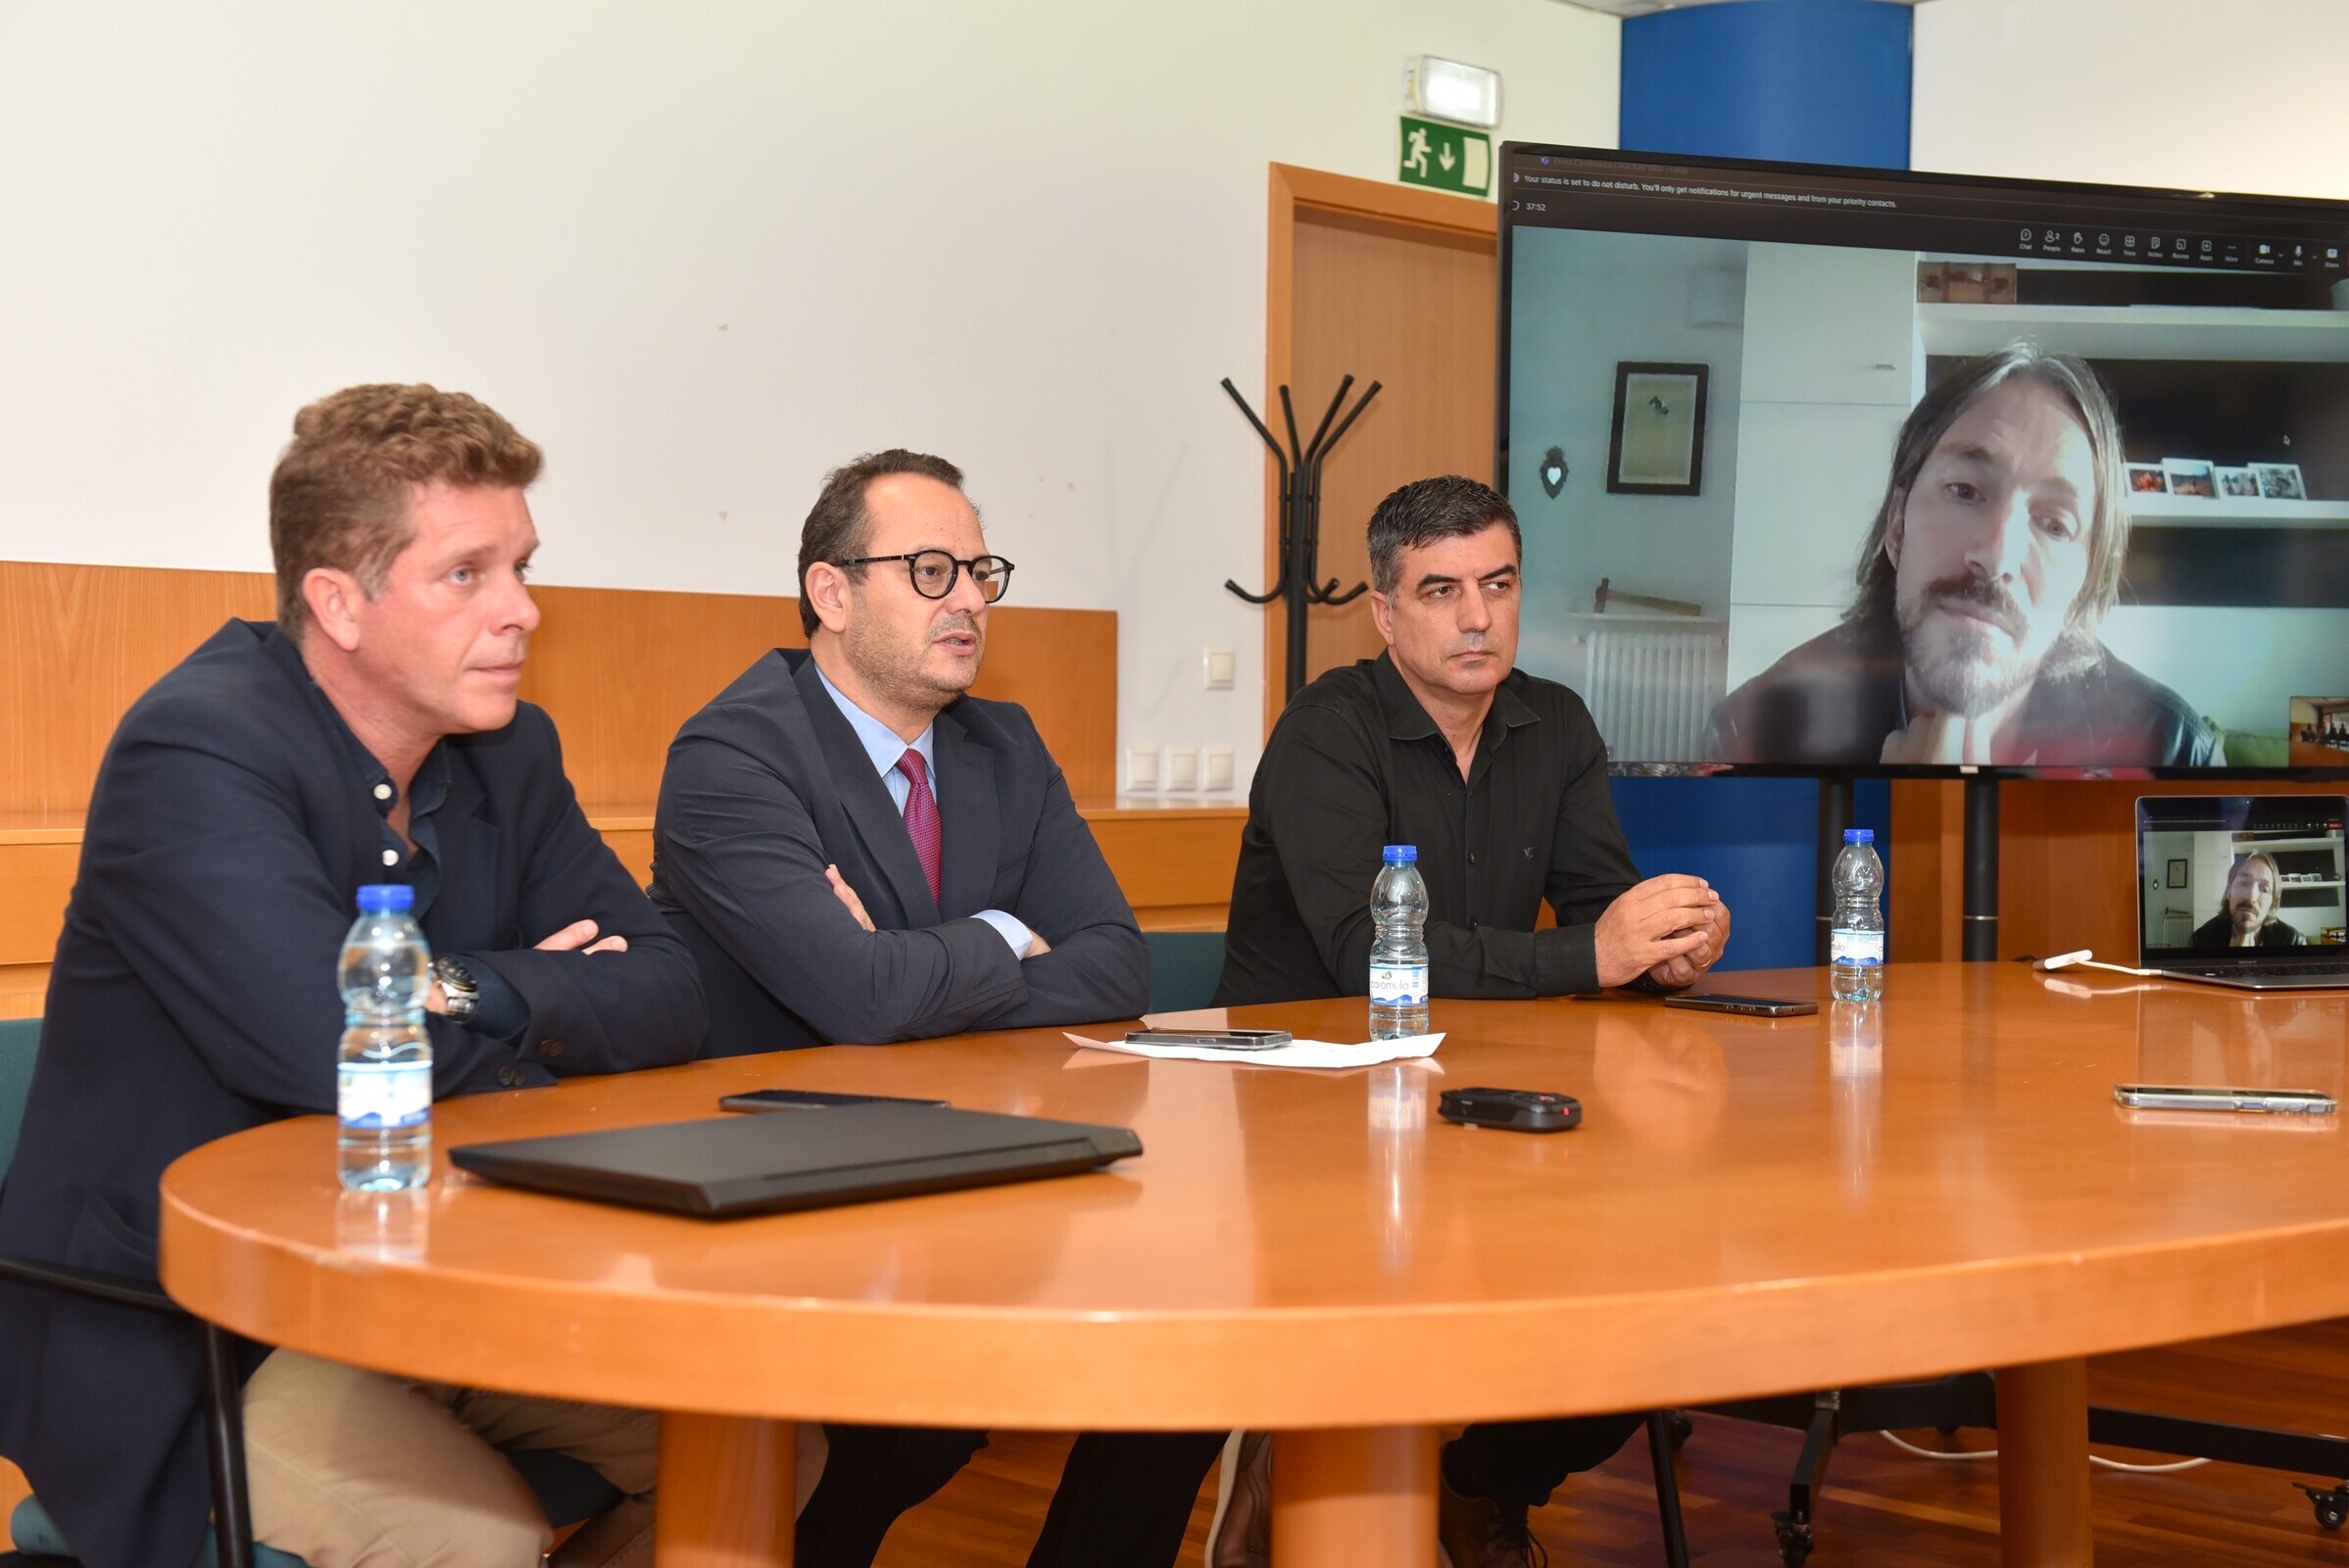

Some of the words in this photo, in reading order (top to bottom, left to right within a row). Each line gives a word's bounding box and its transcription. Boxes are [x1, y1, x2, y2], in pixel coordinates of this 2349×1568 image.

[1524, 174, 1540, 183] Your
[1590, 179, 1600, 188] do
[1614, 181, 1639, 190] disturb.
[1660, 184, 1675, 194] only
[1676, 185, 1688, 195] get
[1688, 186, 1729, 197] notifications
[1740, 191, 1763, 200] urgent
[1763, 193, 1796, 202] messages
[1811, 195, 1827, 204] from
[1827, 197, 1842, 206] your
[1842, 197, 1866, 208] priority
[1867, 199, 1897, 209] contacts.
[1525, 202, 1546, 212] 37:52
[1370, 980, 1409, 990] caramulo
